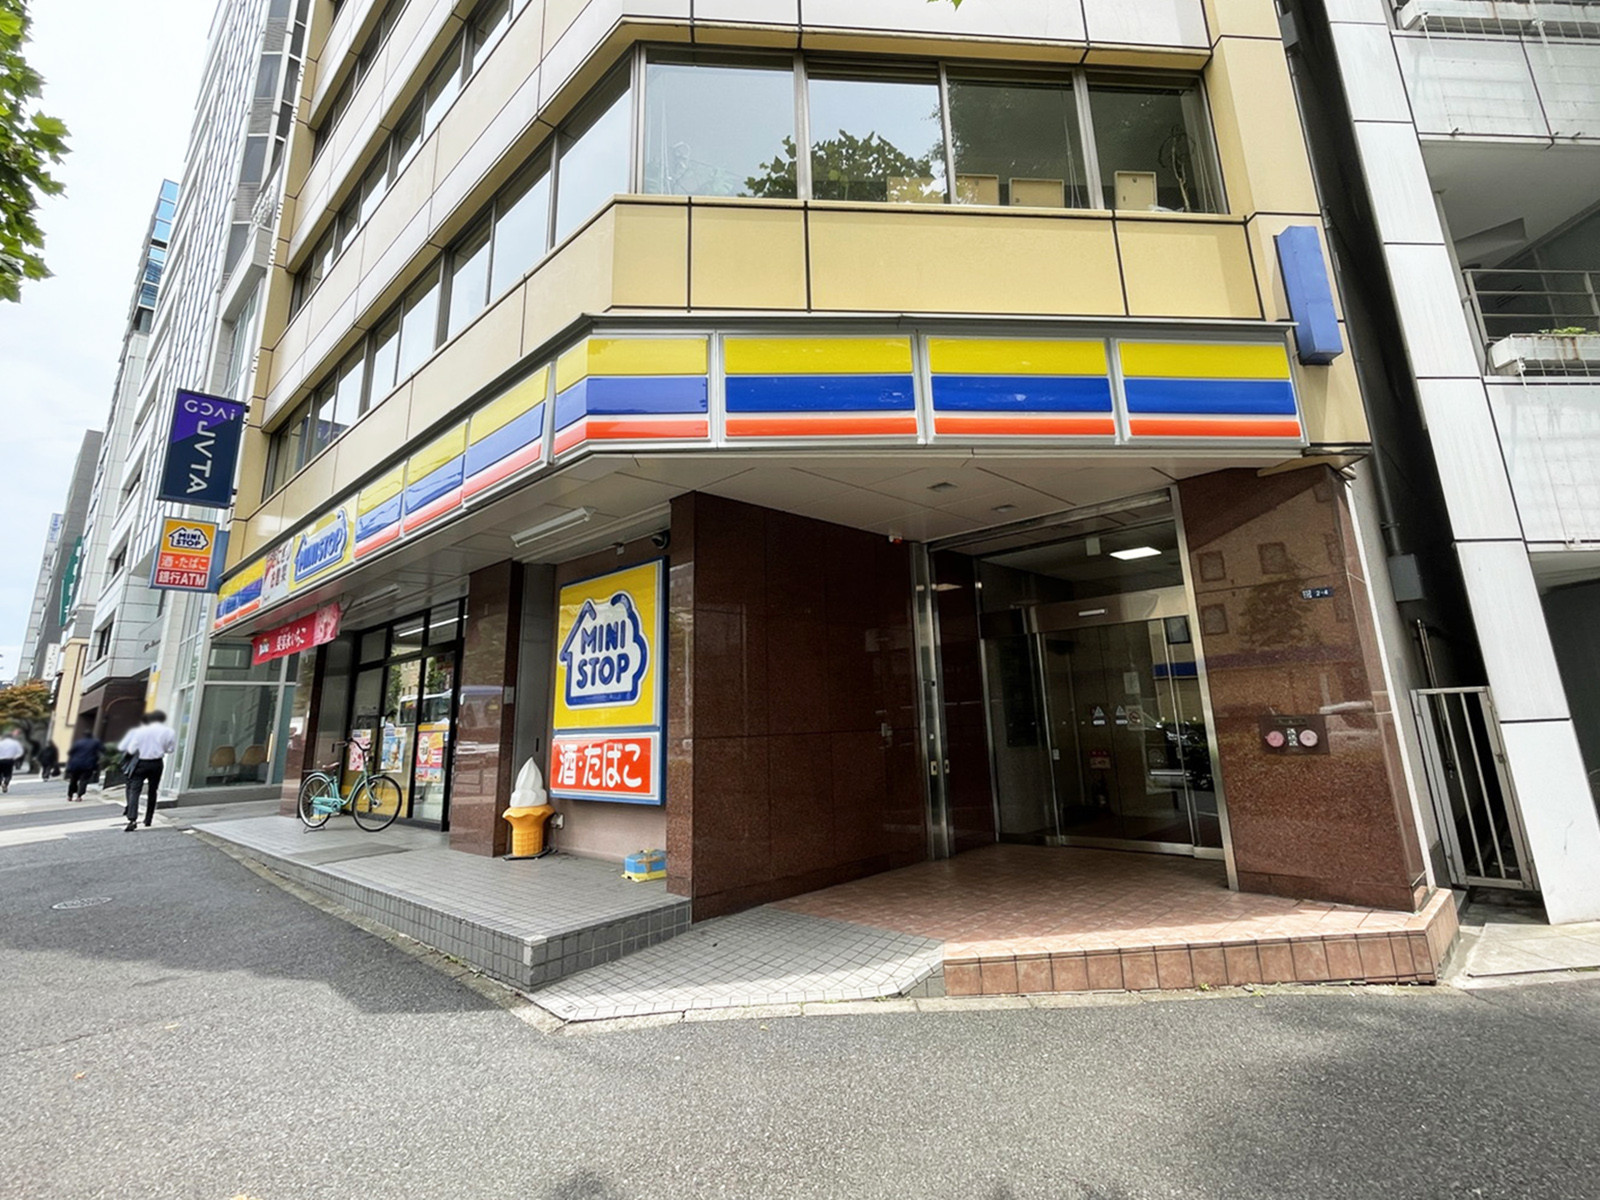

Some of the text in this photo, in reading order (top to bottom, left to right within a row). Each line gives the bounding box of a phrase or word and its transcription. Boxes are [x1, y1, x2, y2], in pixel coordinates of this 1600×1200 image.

[186, 420, 217, 494] JVTA
[175, 539, 202, 547] STOP
[178, 532, 202, 541] MINI
[581, 619, 627, 656] MINI
[576, 652, 631, 690] STOP
